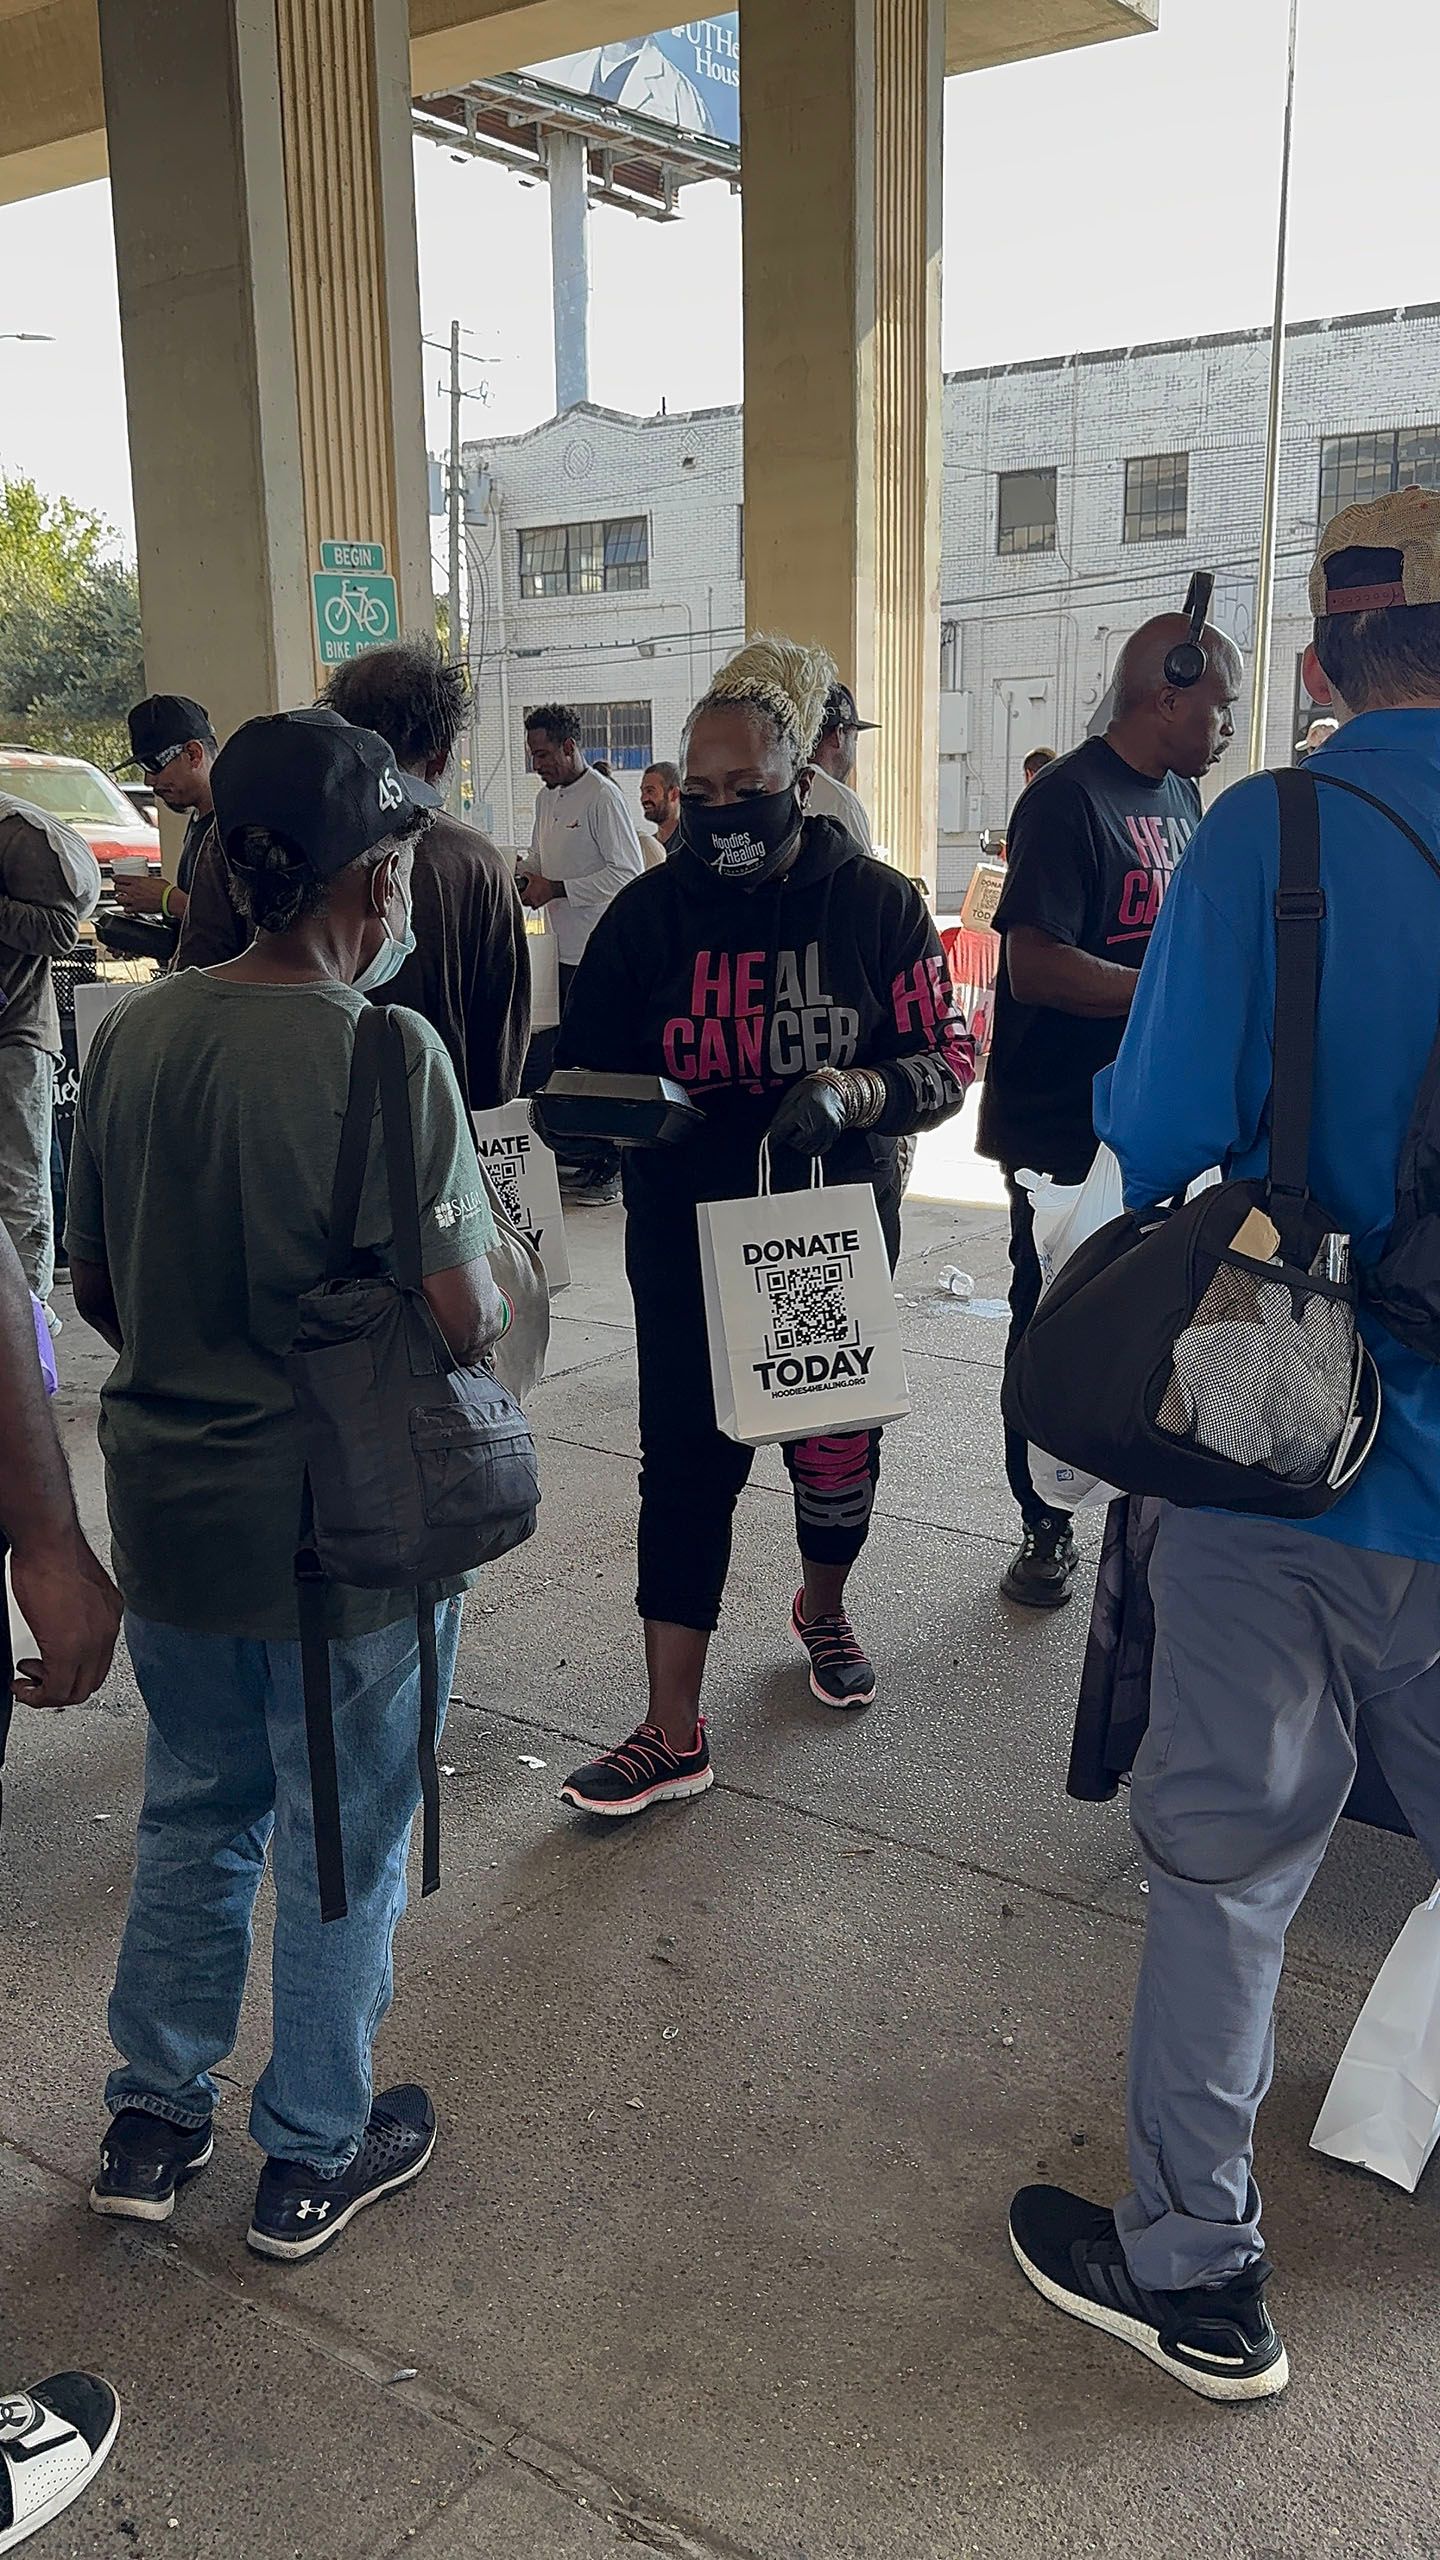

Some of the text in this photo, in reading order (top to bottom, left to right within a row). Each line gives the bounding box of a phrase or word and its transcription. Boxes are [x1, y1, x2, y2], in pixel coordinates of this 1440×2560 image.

[334, 547, 372, 566] BEGIN
[325, 641, 351, 659] BIKE
[379, 767, 402, 811] 45
[711, 832, 751, 849] Hoodies
[724, 841, 766, 864] Healing
[691, 941, 834, 1018] HEAL
[662, 1007, 860, 1081] CANCER
[742, 1229, 860, 1266] DONATE
[753, 1346, 875, 1391] TODAY
[771, 1377, 867, 1399] HOODIES4HEALING.ORG
